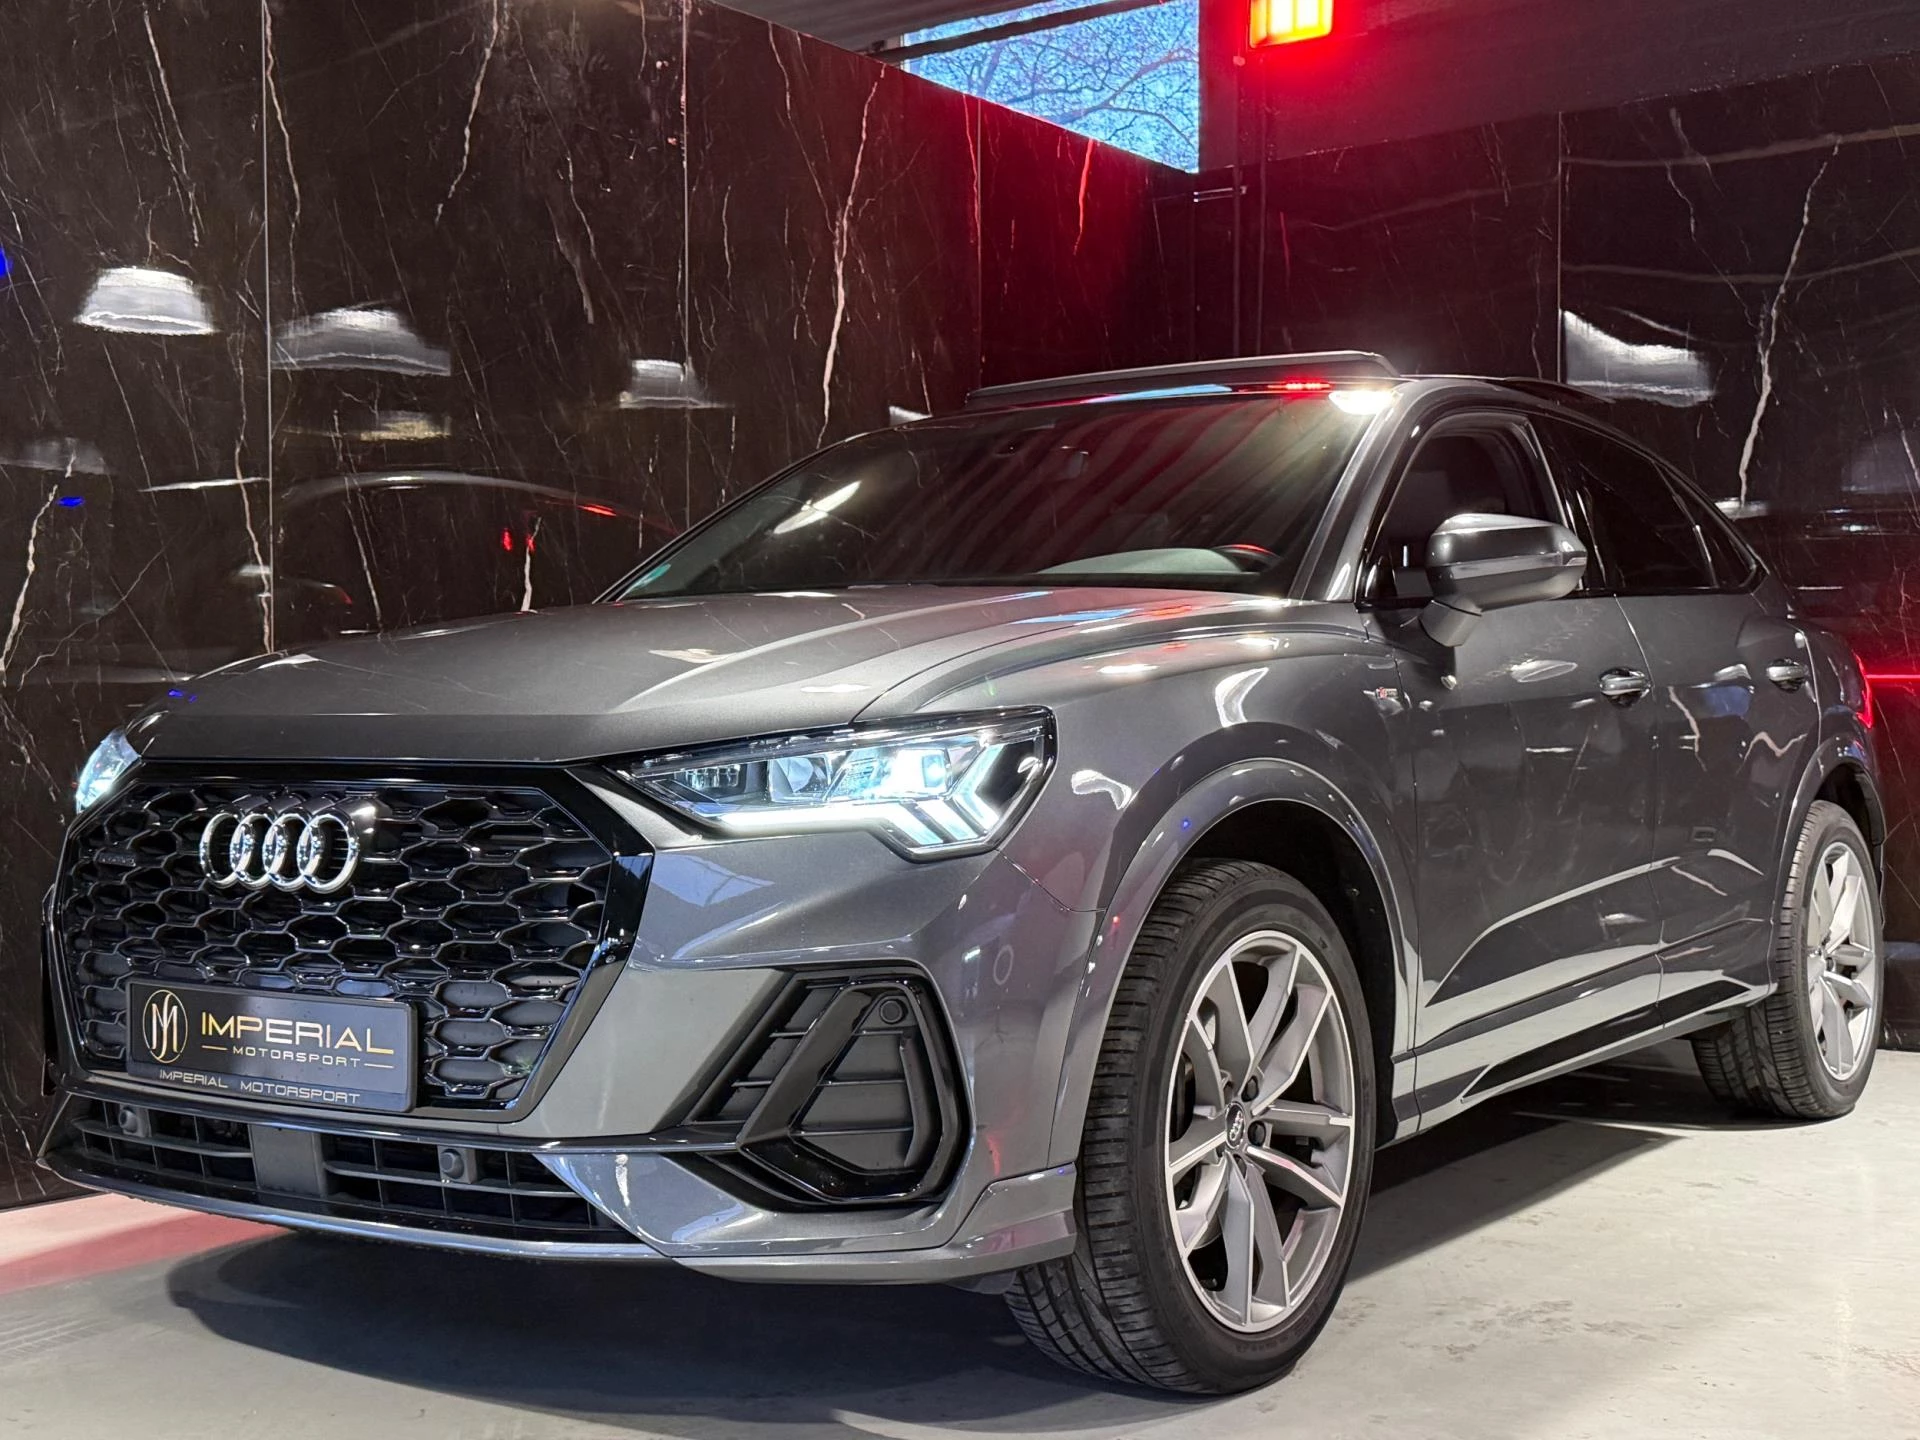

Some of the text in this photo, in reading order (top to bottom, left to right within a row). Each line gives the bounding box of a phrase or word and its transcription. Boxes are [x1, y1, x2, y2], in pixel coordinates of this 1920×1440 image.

[202, 1011, 394, 1055] IMPERIAL
[233, 1046, 361, 1068] MOTORSPORT
[160, 1069, 228, 1089] IMPERIAL
[241, 1080, 361, 1104] MOTORSPORT
